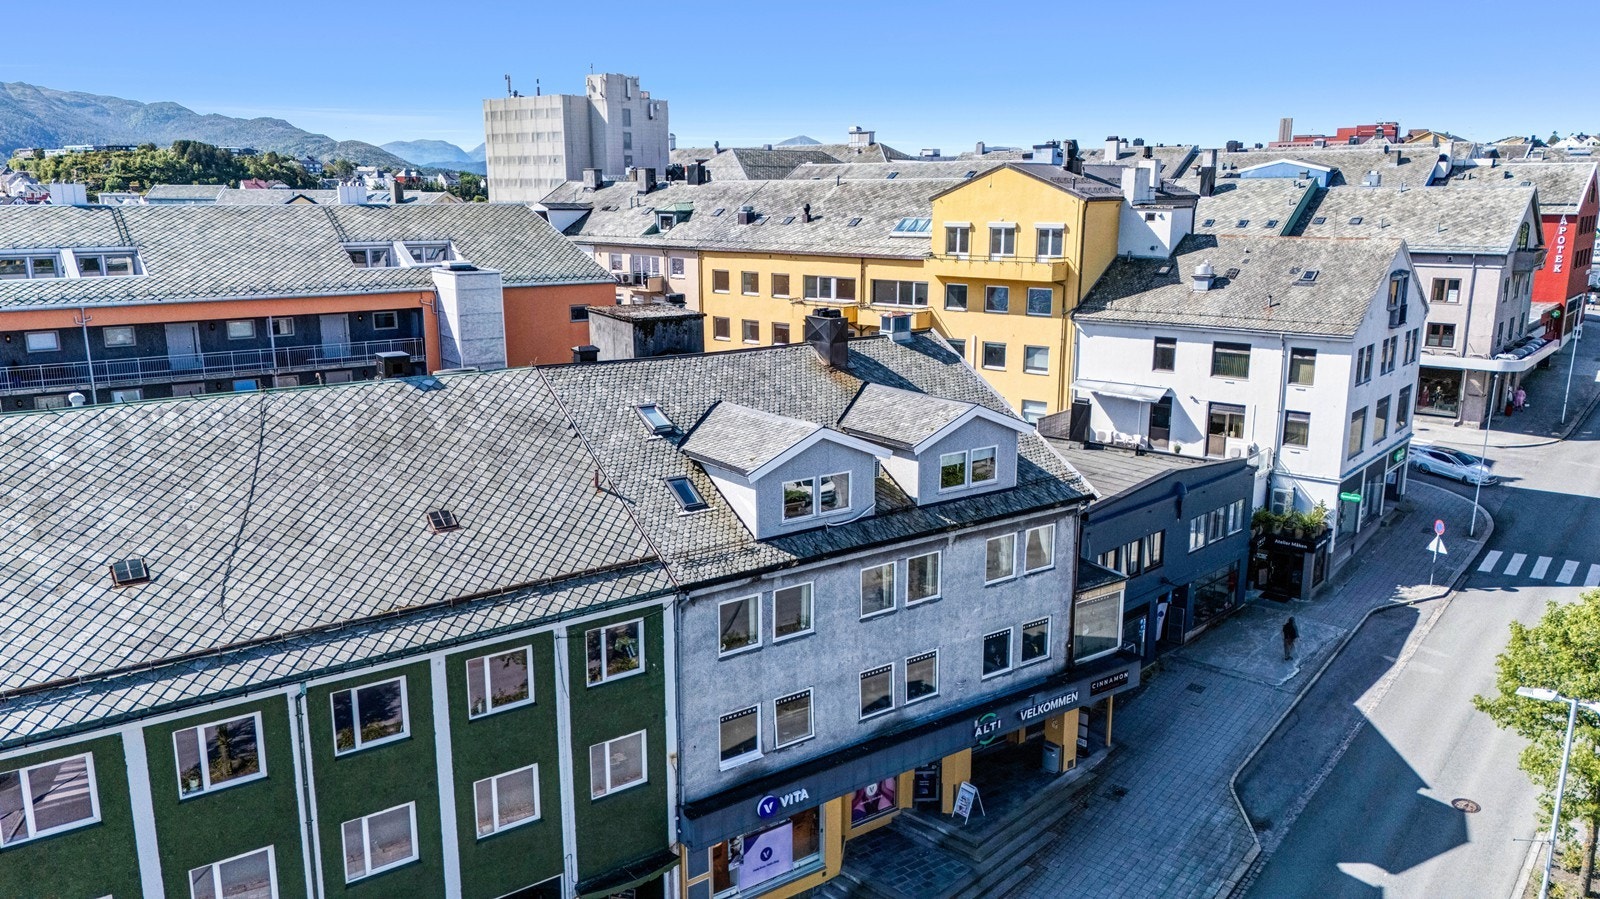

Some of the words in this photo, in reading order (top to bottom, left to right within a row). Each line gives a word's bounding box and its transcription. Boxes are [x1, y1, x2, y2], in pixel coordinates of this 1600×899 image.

[1553, 215, 1568, 273] APOTEK
[1091, 672, 1129, 689] CINNAMON
[776, 691, 811, 705] CINNAMON
[1020, 692, 1079, 720] VELKOMMEN
[720, 708, 757, 722] CINNAMON
[975, 720, 1001, 738] ALTI
[780, 788, 810, 808] VITA
